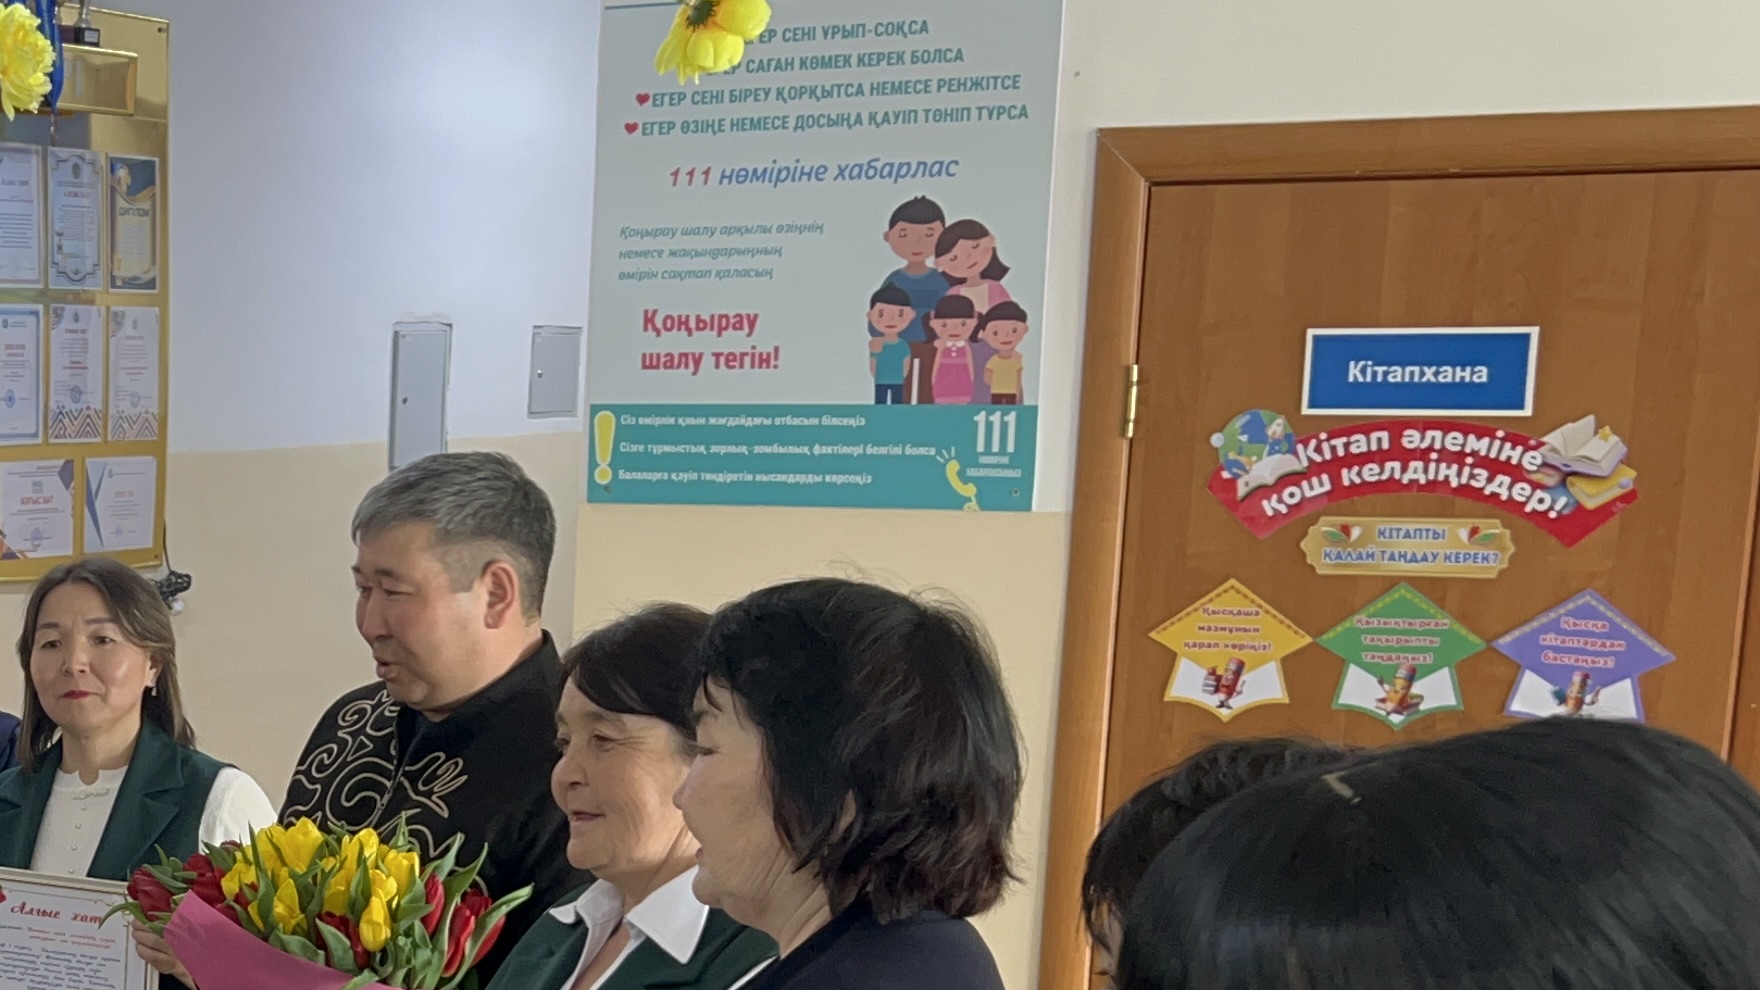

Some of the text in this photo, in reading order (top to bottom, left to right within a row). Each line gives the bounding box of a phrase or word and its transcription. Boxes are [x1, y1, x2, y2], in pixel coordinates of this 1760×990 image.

[782, 26, 817, 43] СЕНІ
[822, 19, 929, 40] ҰРЫП-СОҚСА
[746, 57, 794, 74] САҒАН
[799, 53, 852, 71] КӨМЕК
[857, 50, 906, 68] КЕРЕК
[910, 47, 964, 65] БОЛСА
[651, 74, 1021, 108] ЕГЕР СЕНІ БІРЕУ ҚОРҚЫТСА НЕМЕСЕ РЕНЖІТСЕ
[641, 104, 1029, 137] ЕГЕР ӨЗІҢЕ НЕМЕСЕ ДОСЫҢА ҚАУІП ТӨНІП ТҰРСА
[669, 157, 960, 188] 111 нөміріне хабарлас
[619, 225, 678, 241] Қоңырау
[681, 224, 717, 238] шалу
[720, 222, 773, 238] арқылы
[618, 248, 664, 260] немесе
[618, 266, 774, 282] өмірін сақтап қаласың
[642, 308, 759, 338] Қоңырау
[641, 344, 781, 376] шалу тегін!
[1348, 360, 1488, 383] Кітапхана
[620, 413, 636, 426] Сіз
[973, 410, 1017, 453] 111
[1296, 429, 1543, 471] Кітап әлеміне
[1261, 452, 1568, 518] қош келдіңіздер!
[1377, 526, 1446, 540] КІТАПТЫ
[1323, 546, 1501, 565] ҚАЛАЙ ТАҢДАУ КЕРЕК?
[1201, 606, 1261, 618] Қысқаша
[1561, 617, 1608, 631] Қысқа
[1540, 633, 1625, 650] кітаптардан
[1542, 650, 1615, 668] бастаңыз!
